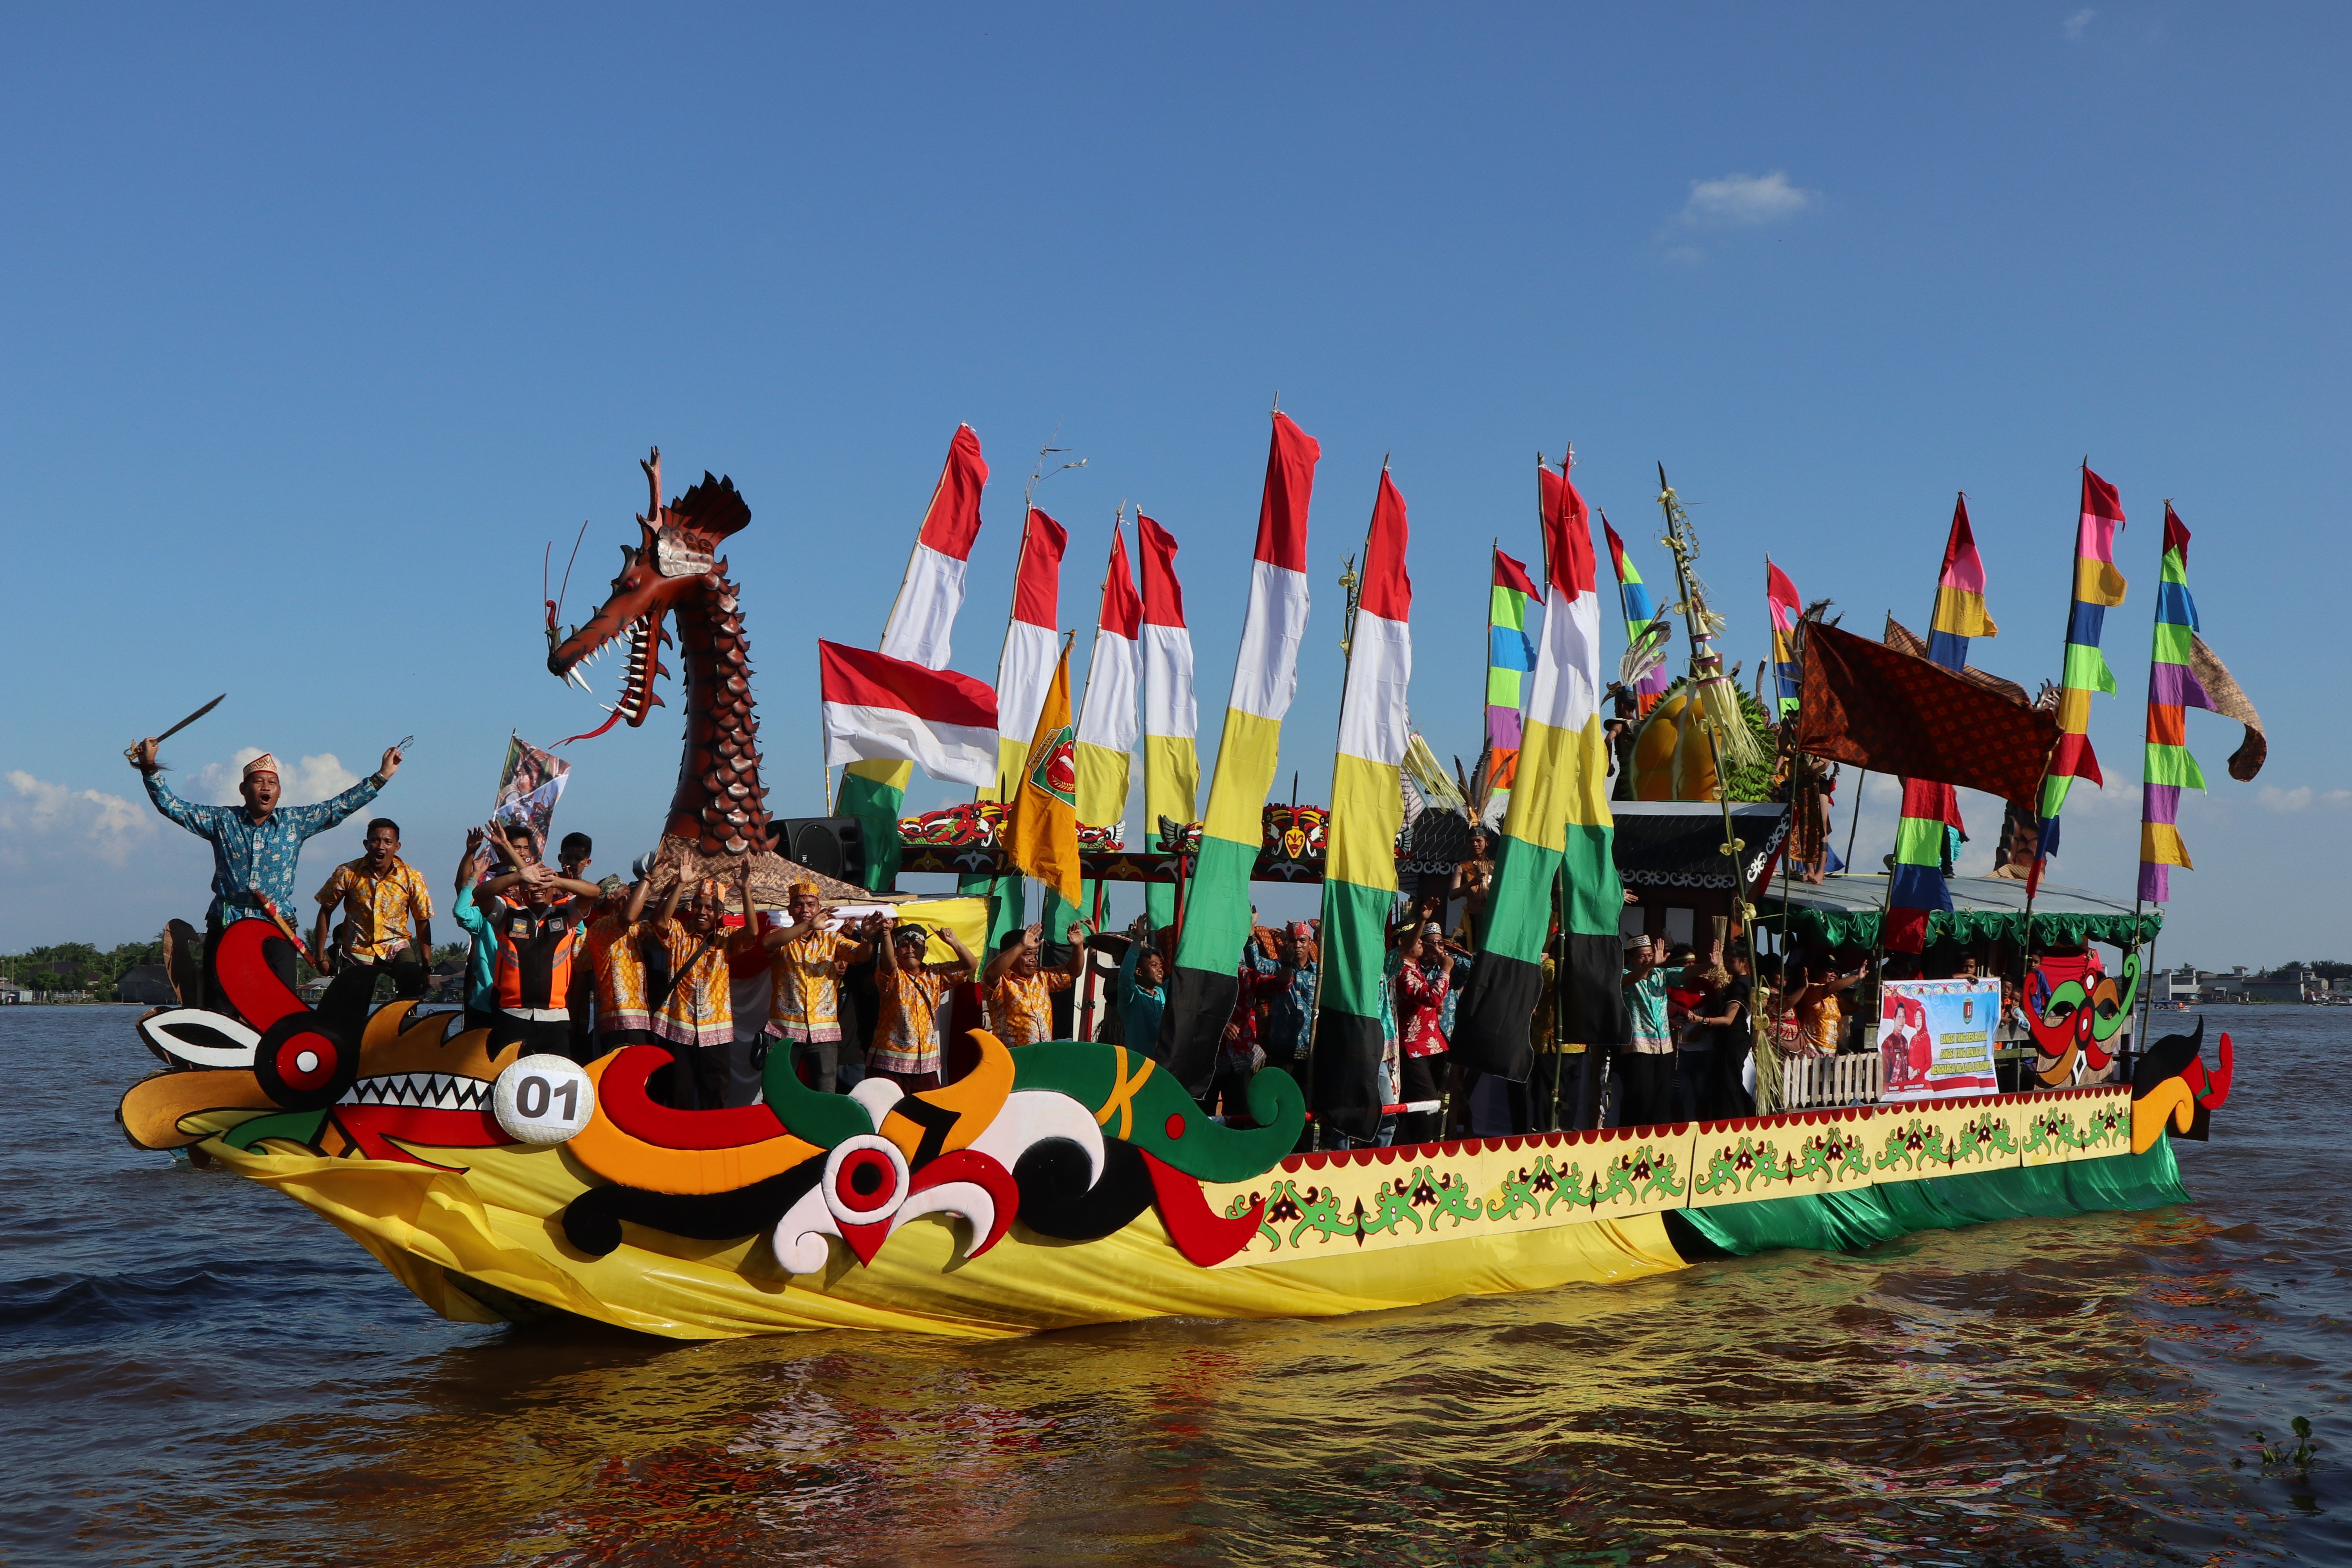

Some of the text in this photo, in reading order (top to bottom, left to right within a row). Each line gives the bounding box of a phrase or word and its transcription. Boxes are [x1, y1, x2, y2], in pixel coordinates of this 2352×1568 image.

[1033, 733, 1053, 764] KABUPATEN
[1036, 737, 1055, 763] KATINGAN
[1940, 1033, 1955, 1044] BANGSA
[1955, 1032, 1965, 1044] YANG
[1965, 1031, 1978, 1043] BESAR
[1940, 1048, 1955, 1060] BANGSA
[1955, 1047, 1965, 1058] YANG
[1965, 1046, 1981, 1058] MENJAGA
[1931, 1063, 1956, 1075] MENGHARGAI
[516, 1076, 579, 1121] 01
